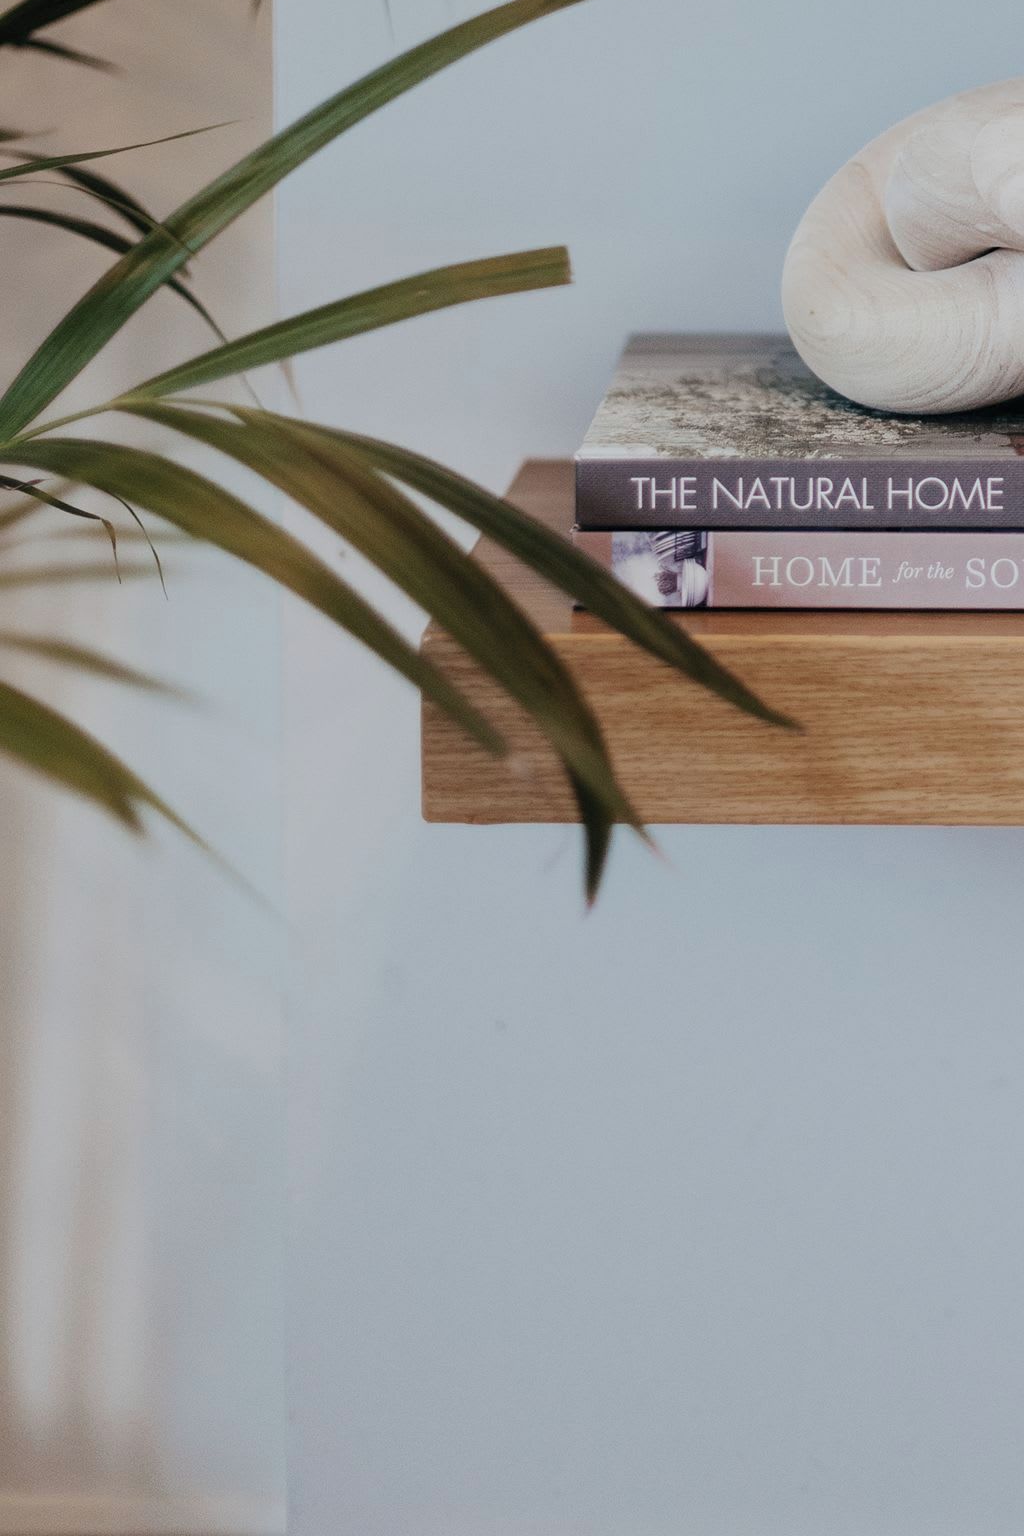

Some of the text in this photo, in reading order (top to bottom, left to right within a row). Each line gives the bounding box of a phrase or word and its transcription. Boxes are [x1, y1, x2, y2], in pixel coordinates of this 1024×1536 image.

[631, 476, 1004, 511] THE NATURAL HOME
[752, 556, 882, 587] HOME
[893, 560, 922, 583] for
[927, 561, 954, 580] the
